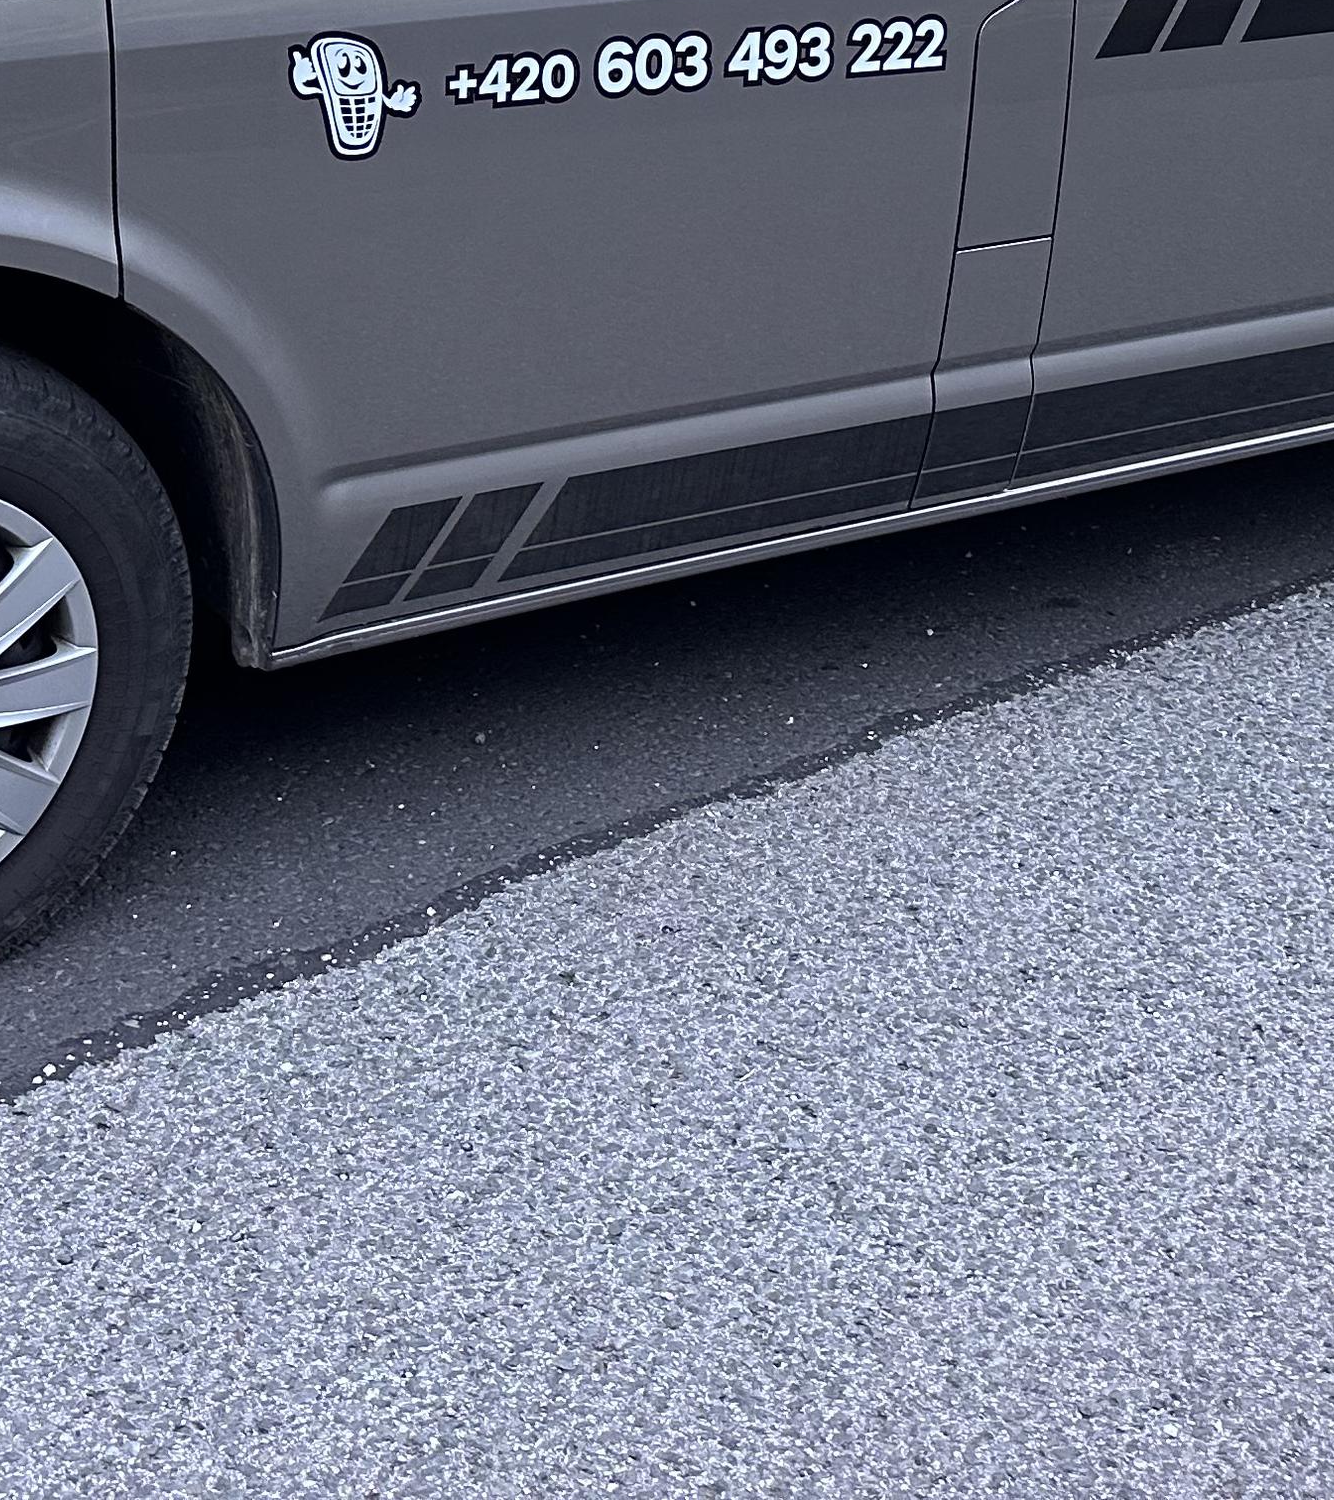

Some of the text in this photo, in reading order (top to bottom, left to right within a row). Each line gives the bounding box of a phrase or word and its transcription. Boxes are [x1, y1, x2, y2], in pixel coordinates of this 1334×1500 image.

[448, 18, 946, 104] +420 603 493 222
